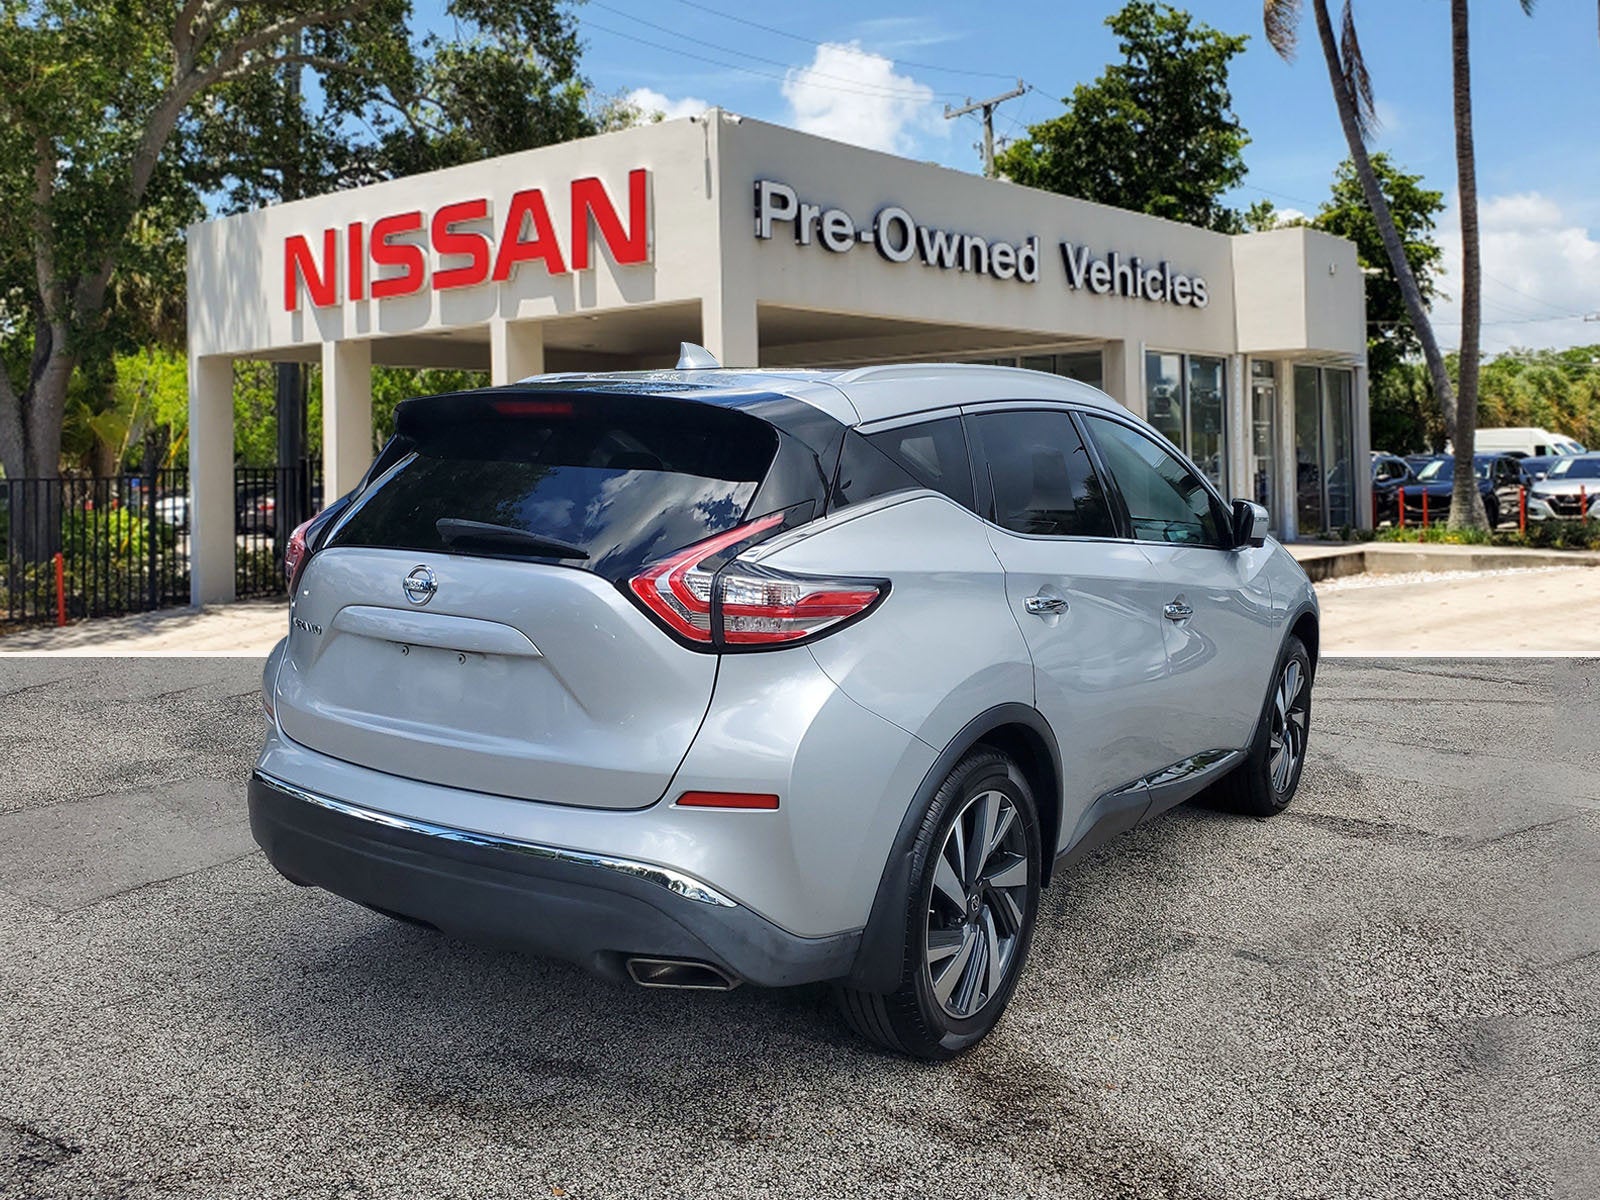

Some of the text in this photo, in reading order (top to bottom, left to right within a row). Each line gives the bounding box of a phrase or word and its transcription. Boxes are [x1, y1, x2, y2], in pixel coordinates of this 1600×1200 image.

[285, 168, 646, 312] NISSAN
[754, 180, 1209, 309] Pre-Owned Vehicles
[403, 580, 433, 591] NISSAN
